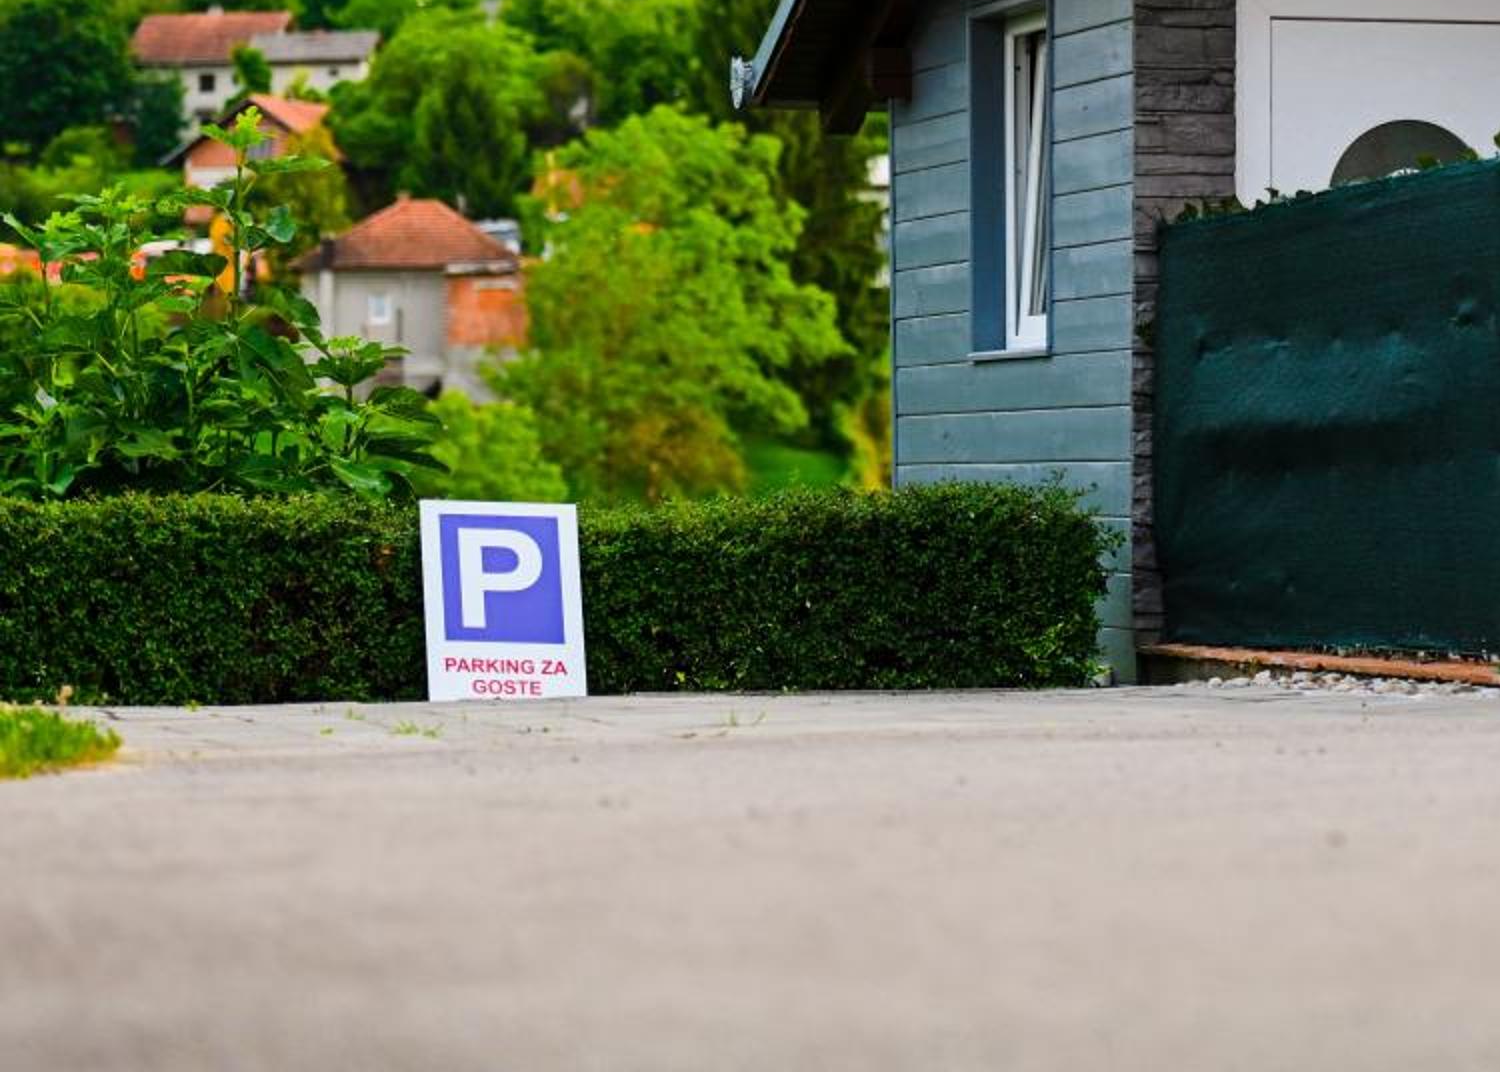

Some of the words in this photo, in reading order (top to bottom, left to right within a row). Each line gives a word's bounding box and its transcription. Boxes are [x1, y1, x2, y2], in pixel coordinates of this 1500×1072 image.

[457, 527, 544, 629] P
[445, 657, 535, 675] PARKING
[541, 659, 568, 676] ZA
[472, 679, 542, 696] GOSTE
